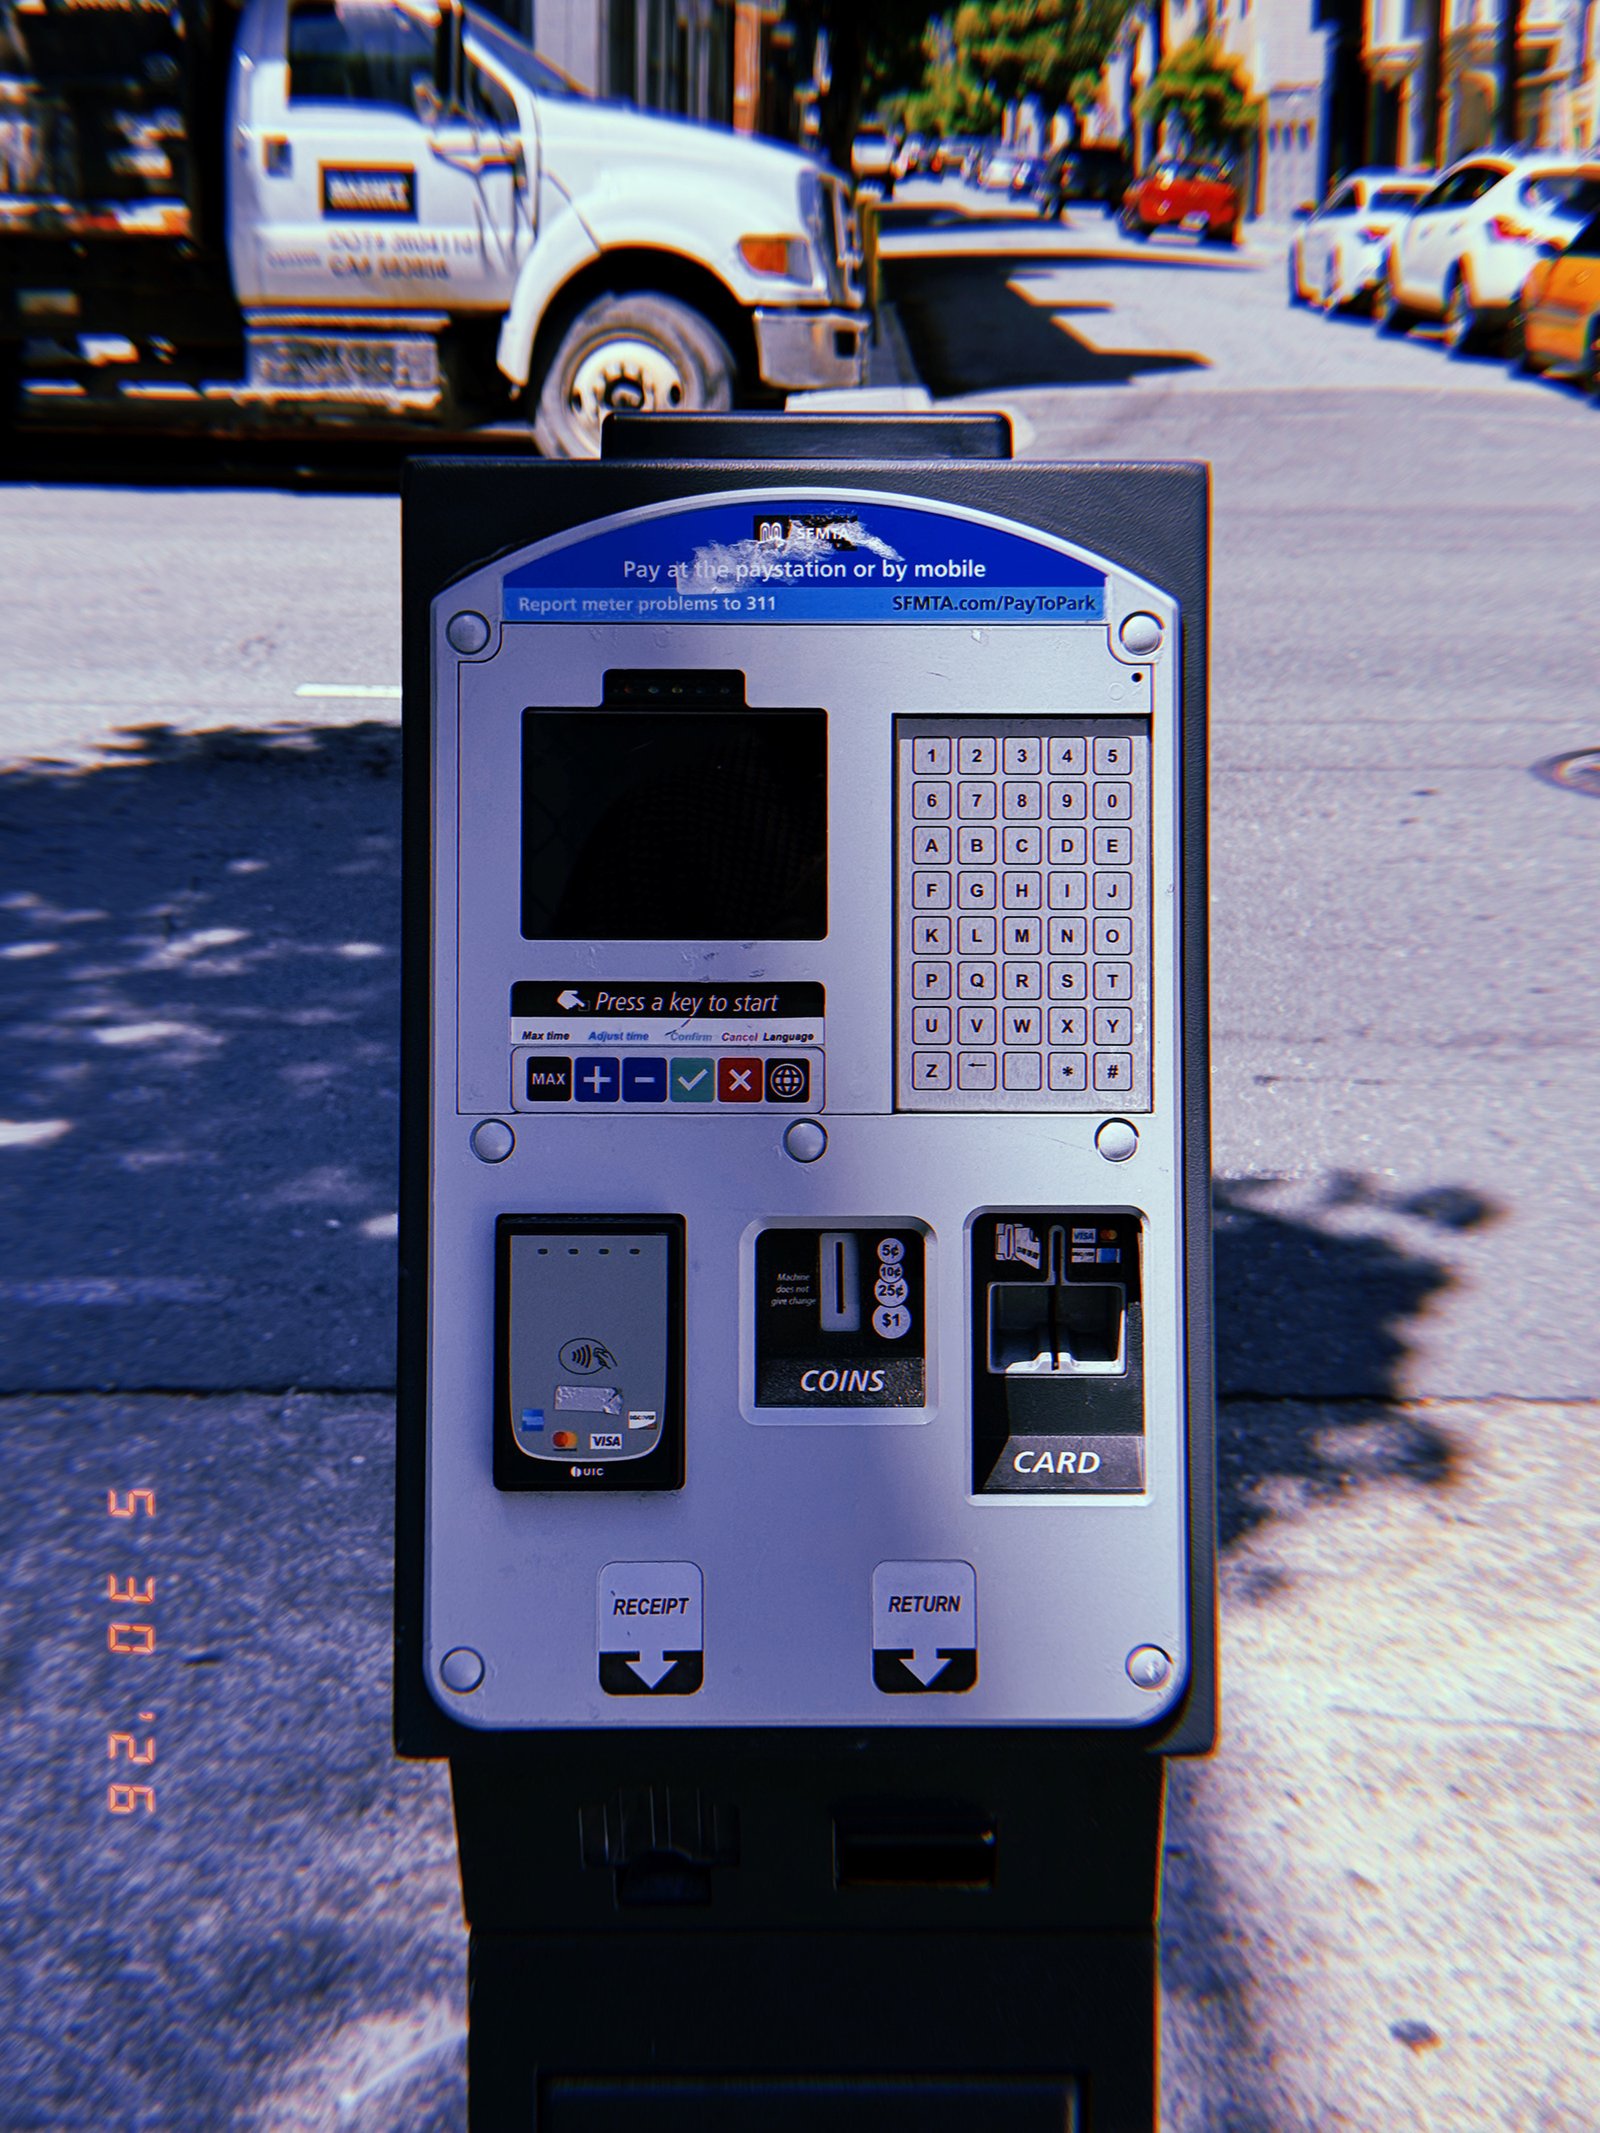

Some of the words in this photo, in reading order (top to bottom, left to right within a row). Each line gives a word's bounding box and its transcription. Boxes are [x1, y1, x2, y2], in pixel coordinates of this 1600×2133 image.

[796, 527, 850, 540] SFMTA
[624, 561, 661, 582] Pay
[667, 562, 689, 578] at
[693, 561, 729, 578] the
[735, 560, 847, 581] paystation
[854, 564, 874, 578] or
[882, 560, 908, 581] by
[915, 560, 986, 578] mobile
[519, 598, 576, 614] Report
[582, 597, 632, 611] meter
[639, 596, 718, 614] problems
[723, 598, 742, 610] to
[746, 597, 776, 610] 311
[892, 595, 1096, 614] SFMTA.com/PayToPark
[927, 748, 935, 763] 1
[972, 748, 982, 763] 2
[1017, 748, 1028, 763] 3
[1061, 749, 1073, 763] 4
[1107, 749, 1118, 763] 5
[927, 793, 937, 808] 6
[972, 793, 982, 808] 7
[1017, 793, 1027, 808] 8
[1062, 793, 1072, 808] 9
[925, 838, 939, 853] A
[970, 838, 983, 853] B
[1015, 838, 1028, 853] C
[1061, 838, 1074, 853] D
[1107, 839, 1118, 853] E
[926, 883, 937, 898] F
[970, 883, 984, 898] G
[1016, 883, 1028, 898] H
[1065, 883, 1070, 898] I
[1107, 884, 1117, 898] J
[925, 928, 939, 943] K
[972, 928, 983, 943] L
[1015, 928, 1029, 943] M
[1061, 929, 1073, 943] N
[926, 973, 938, 988] P
[970, 973, 984, 988] Q
[1016, 973, 1029, 988] R
[1061, 973, 1073, 988] S
[1106, 974, 1119, 988] T
[595, 992, 645, 1011] Press
[651, 997, 662, 1011] a
[669, 992, 700, 1015] key
[708, 994, 728, 1011] to
[733, 994, 779, 1011] start
[925, 1018, 938, 1033] U
[970, 1018, 983, 1033] V
[1013, 1019, 1031, 1033] W
[1061, 1019, 1074, 1034] X
[1106, 1019, 1119, 1034] Y
[521, 1030, 544, 1041] Max
[547, 1030, 570, 1041] time
[588, 1031, 624, 1043] Adjust
[626, 1031, 649, 1041] time
[670, 1032, 713, 1042] Confirm
[721, 1032, 758, 1042] Cancel
[763, 1032, 814, 1043] Language
[925, 1063, 938, 1078] Z
[532, 1073, 565, 1085] MAX
[882, 1244, 900, 1258] 5¢
[881, 1267, 902, 1278] 10¢
[878, 1284, 904, 1298] 25¢
[882, 1313, 900, 1327] $1
[801, 1370, 885, 1392] COINS
[592, 1436, 620, 1446] VISA
[1013, 1451, 1101, 1473] CARD
[583, 1468, 604, 1476] UIC
[613, 1598, 689, 1615] RECEIPT
[888, 1596, 961, 1612] RETURN
